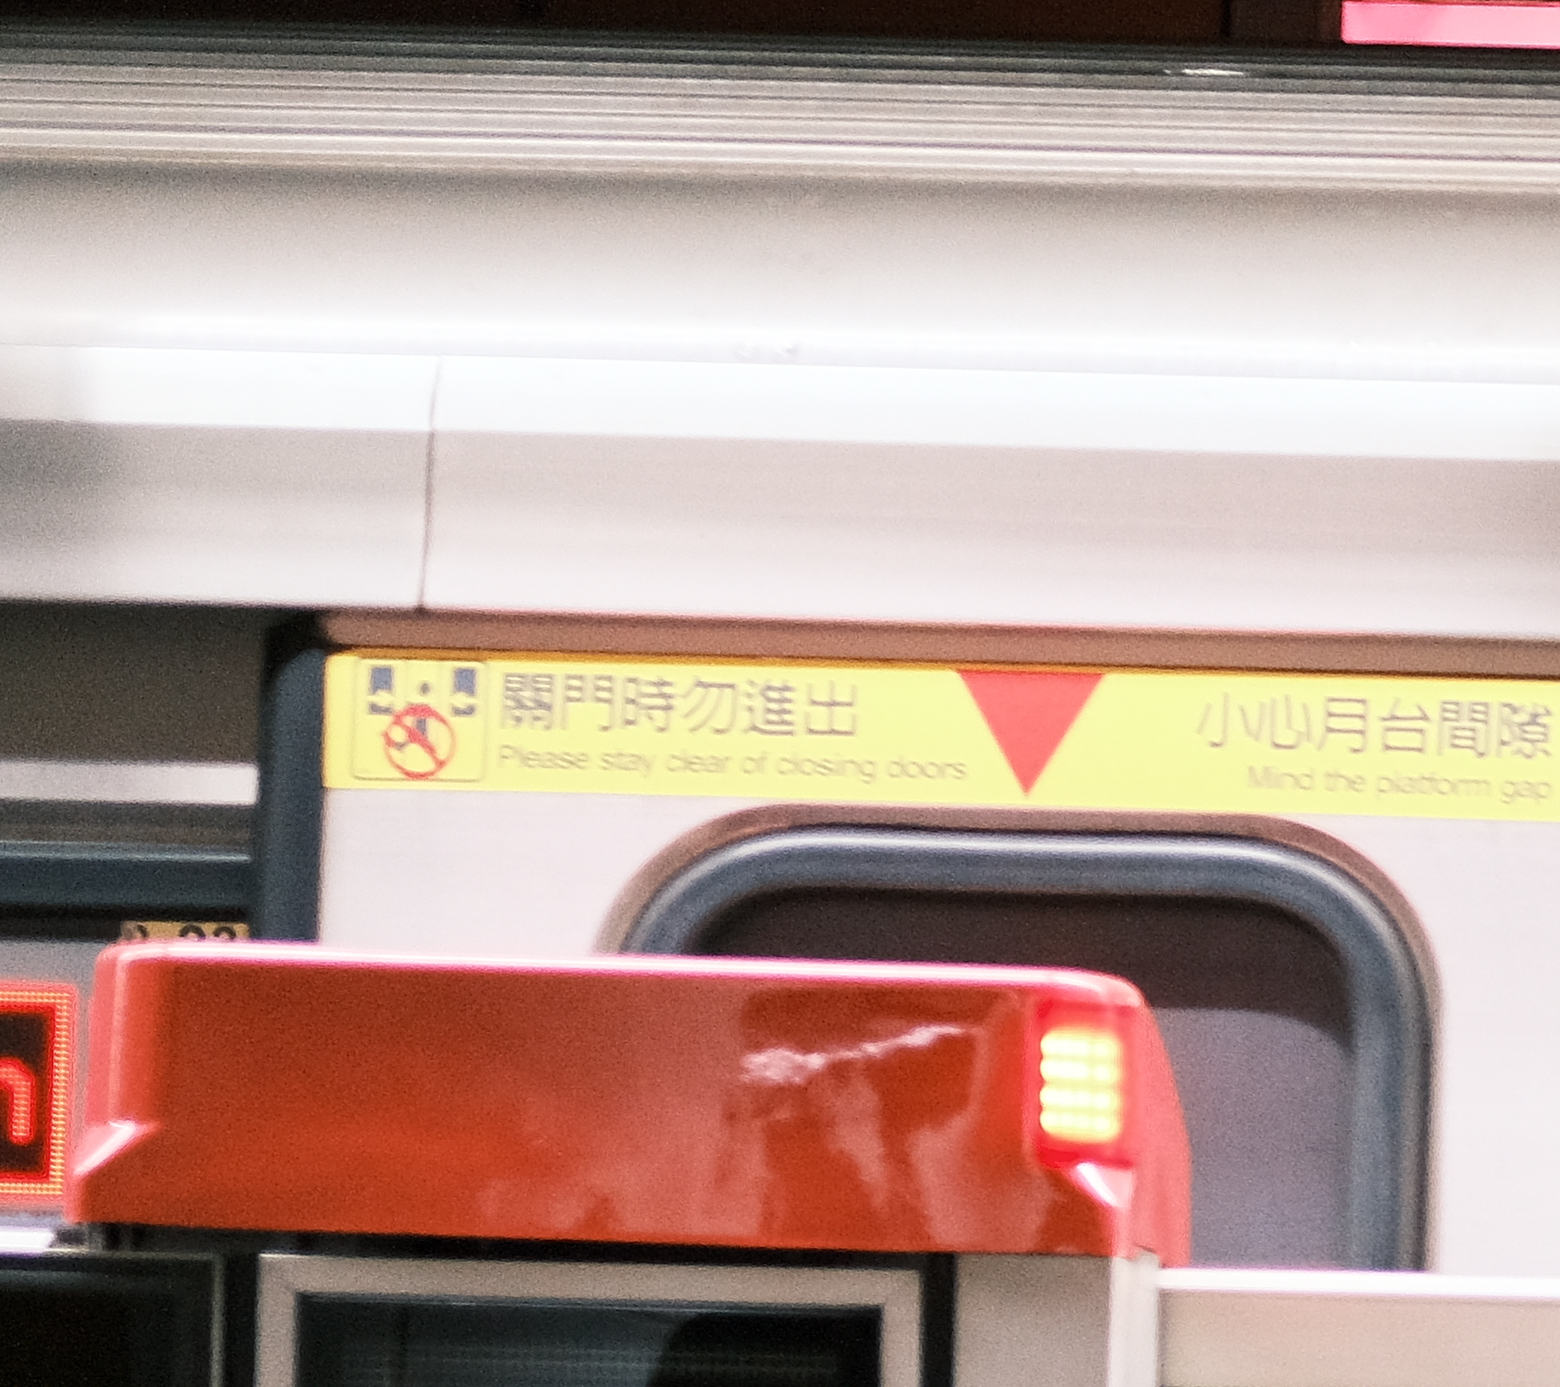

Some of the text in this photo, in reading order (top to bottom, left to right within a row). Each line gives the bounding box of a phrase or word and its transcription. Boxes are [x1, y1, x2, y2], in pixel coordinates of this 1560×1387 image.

[502, 672, 858, 736] 關門時勿進出
[1197, 693, 1553, 759] 小心月台間隙
[499, 745, 967, 784] Please stay clear of closing doors
[1249, 766, 1552, 805] Mind the platform gap
